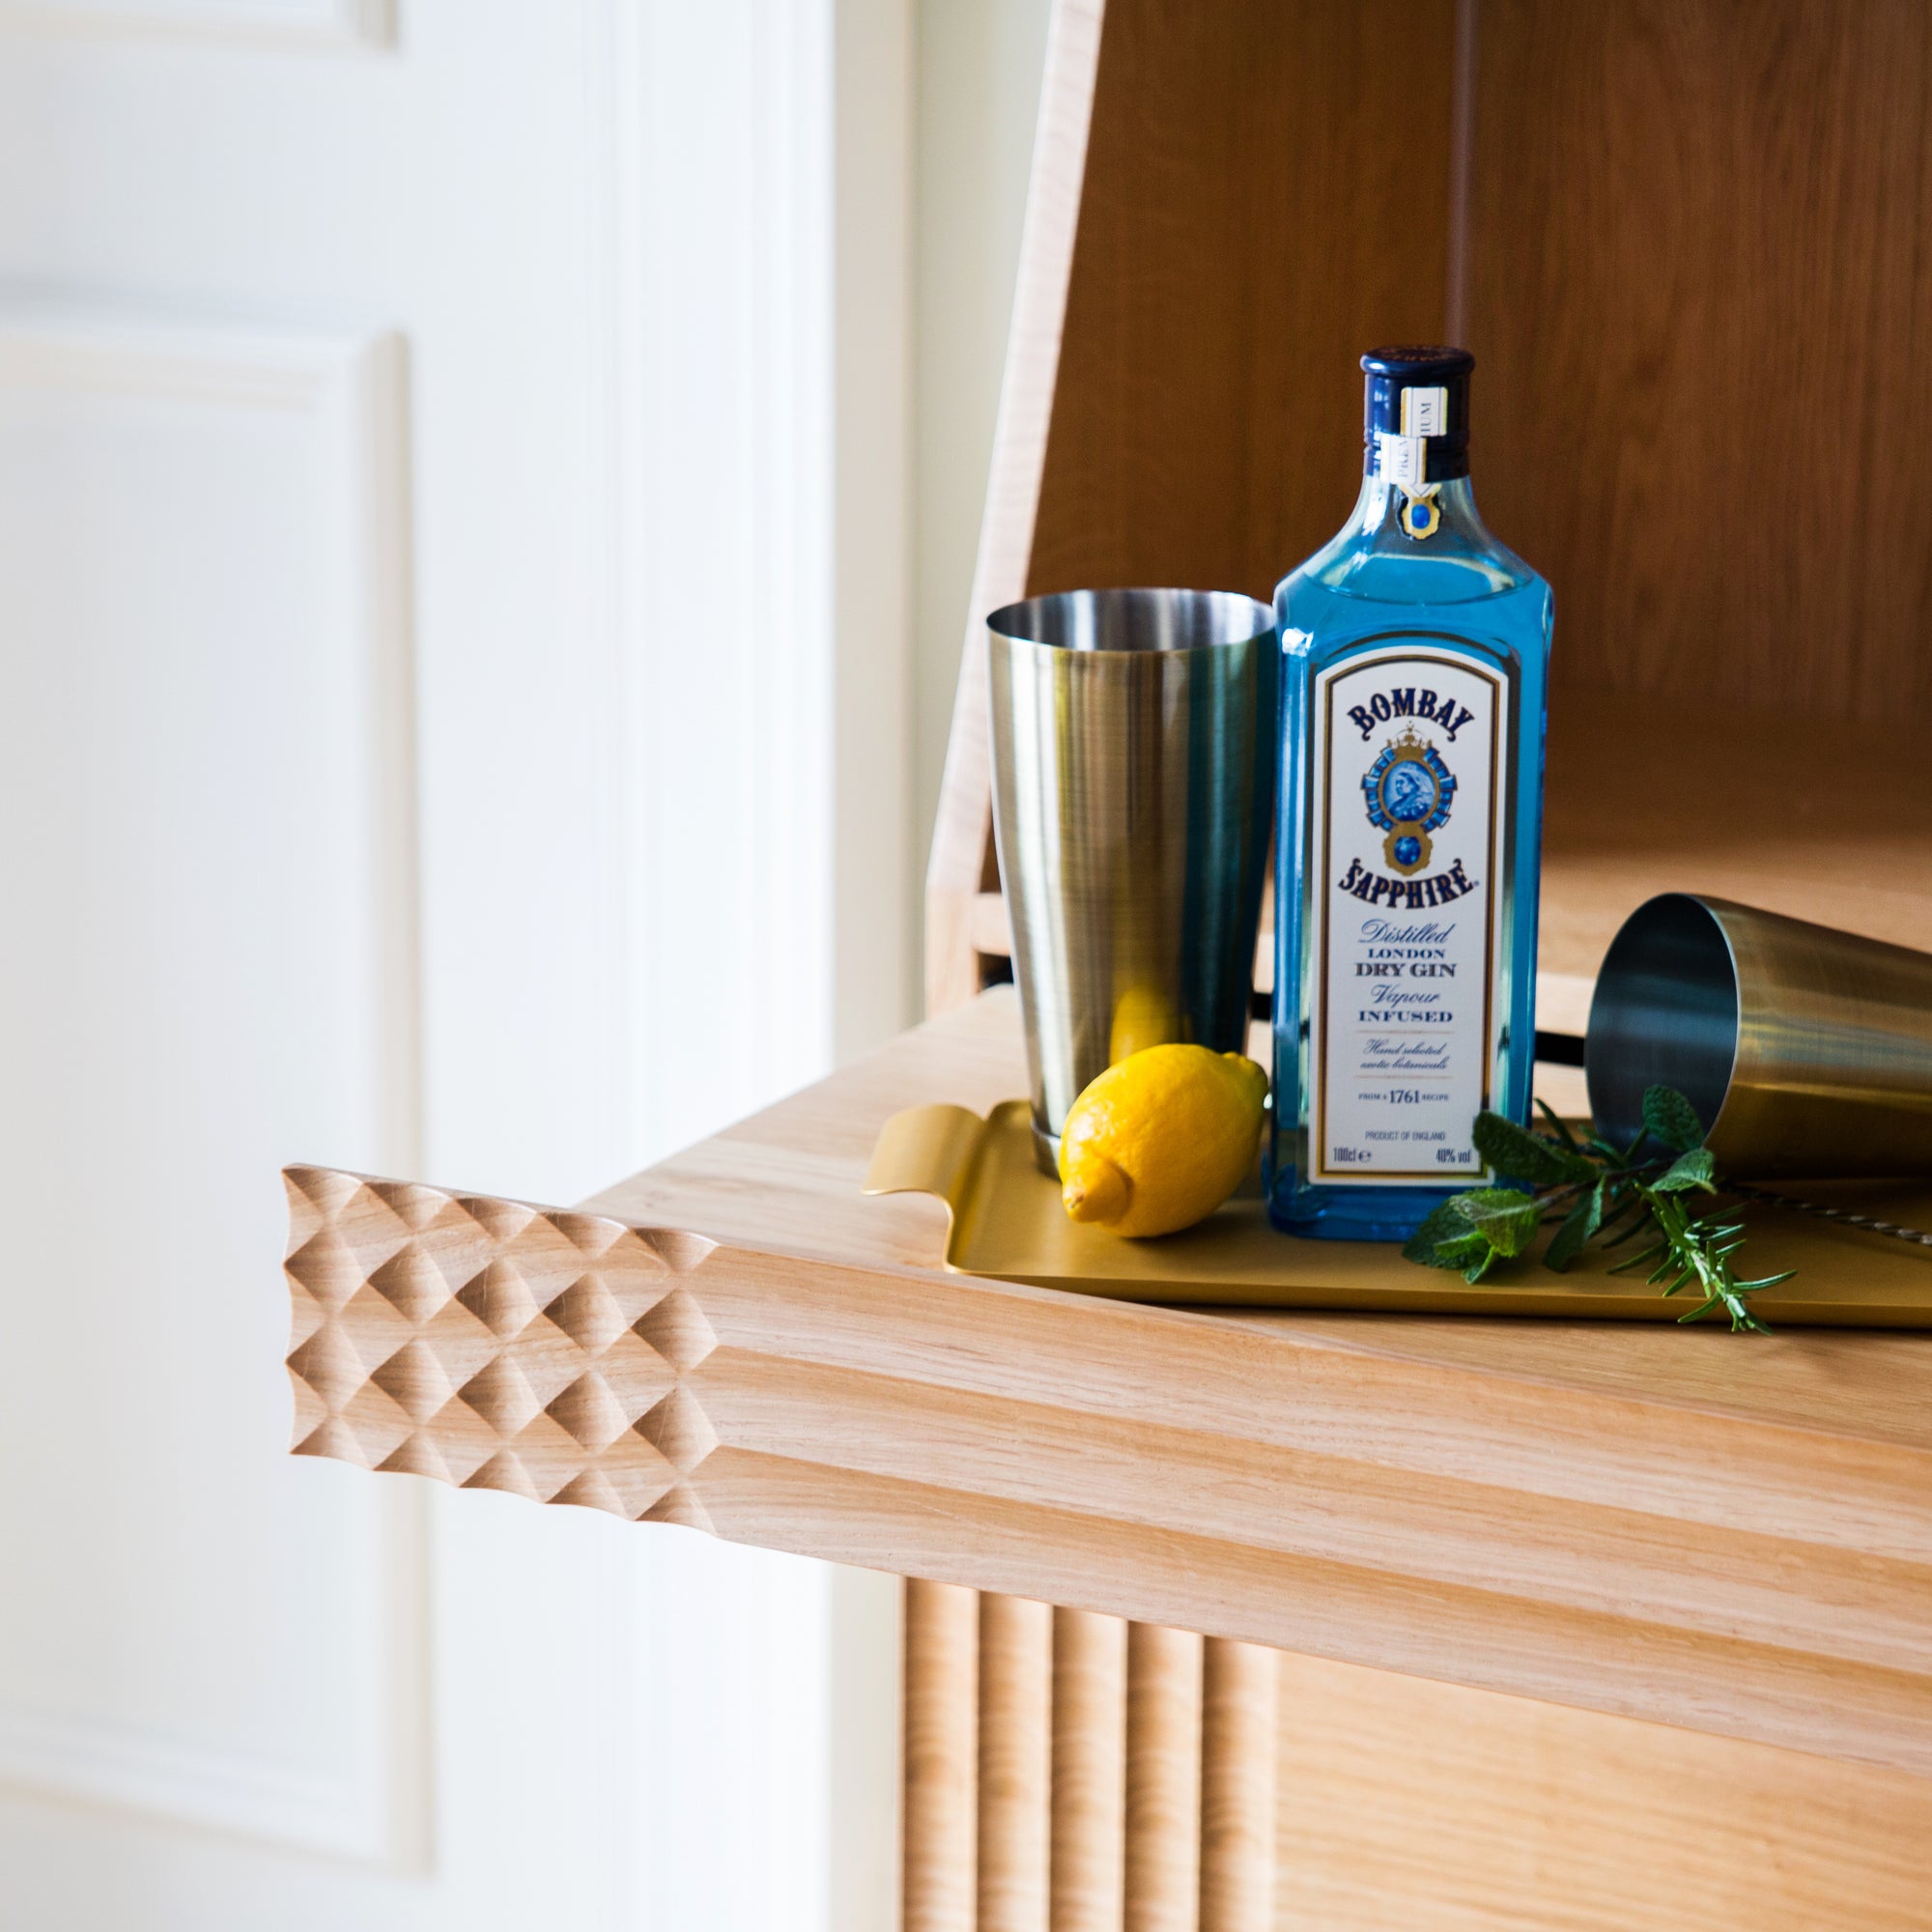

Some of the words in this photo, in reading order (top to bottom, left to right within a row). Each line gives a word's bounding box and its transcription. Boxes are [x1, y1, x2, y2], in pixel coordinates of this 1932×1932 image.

[1347, 687, 1475, 743] BOMBAY
[1337, 858, 1476, 910] SAPPHIRE
[1357, 918, 1457, 945] Distilled
[1368, 949, 1445, 959] LONDON
[1354, 963, 1405, 978] DRY
[1409, 963, 1457, 978] GIN
[1370, 983, 1440, 1009] Vapour
[1357, 1010, 1454, 1023] INFUSED
[1363, 1038, 1403, 1055] Hand
[1402, 1042, 1447, 1055] selected
[1392, 1055, 1450, 1070] botanicals
[1389, 1090, 1420, 1104] 1761
[1365, 1131, 1399, 1141] PRODUCT
[1401, 1131, 1410, 1141] OF
[1412, 1131, 1445, 1141] ENGLAND
[1435, 1149, 1456, 1163] 40%
[1457, 1149, 1471, 1163] vol
